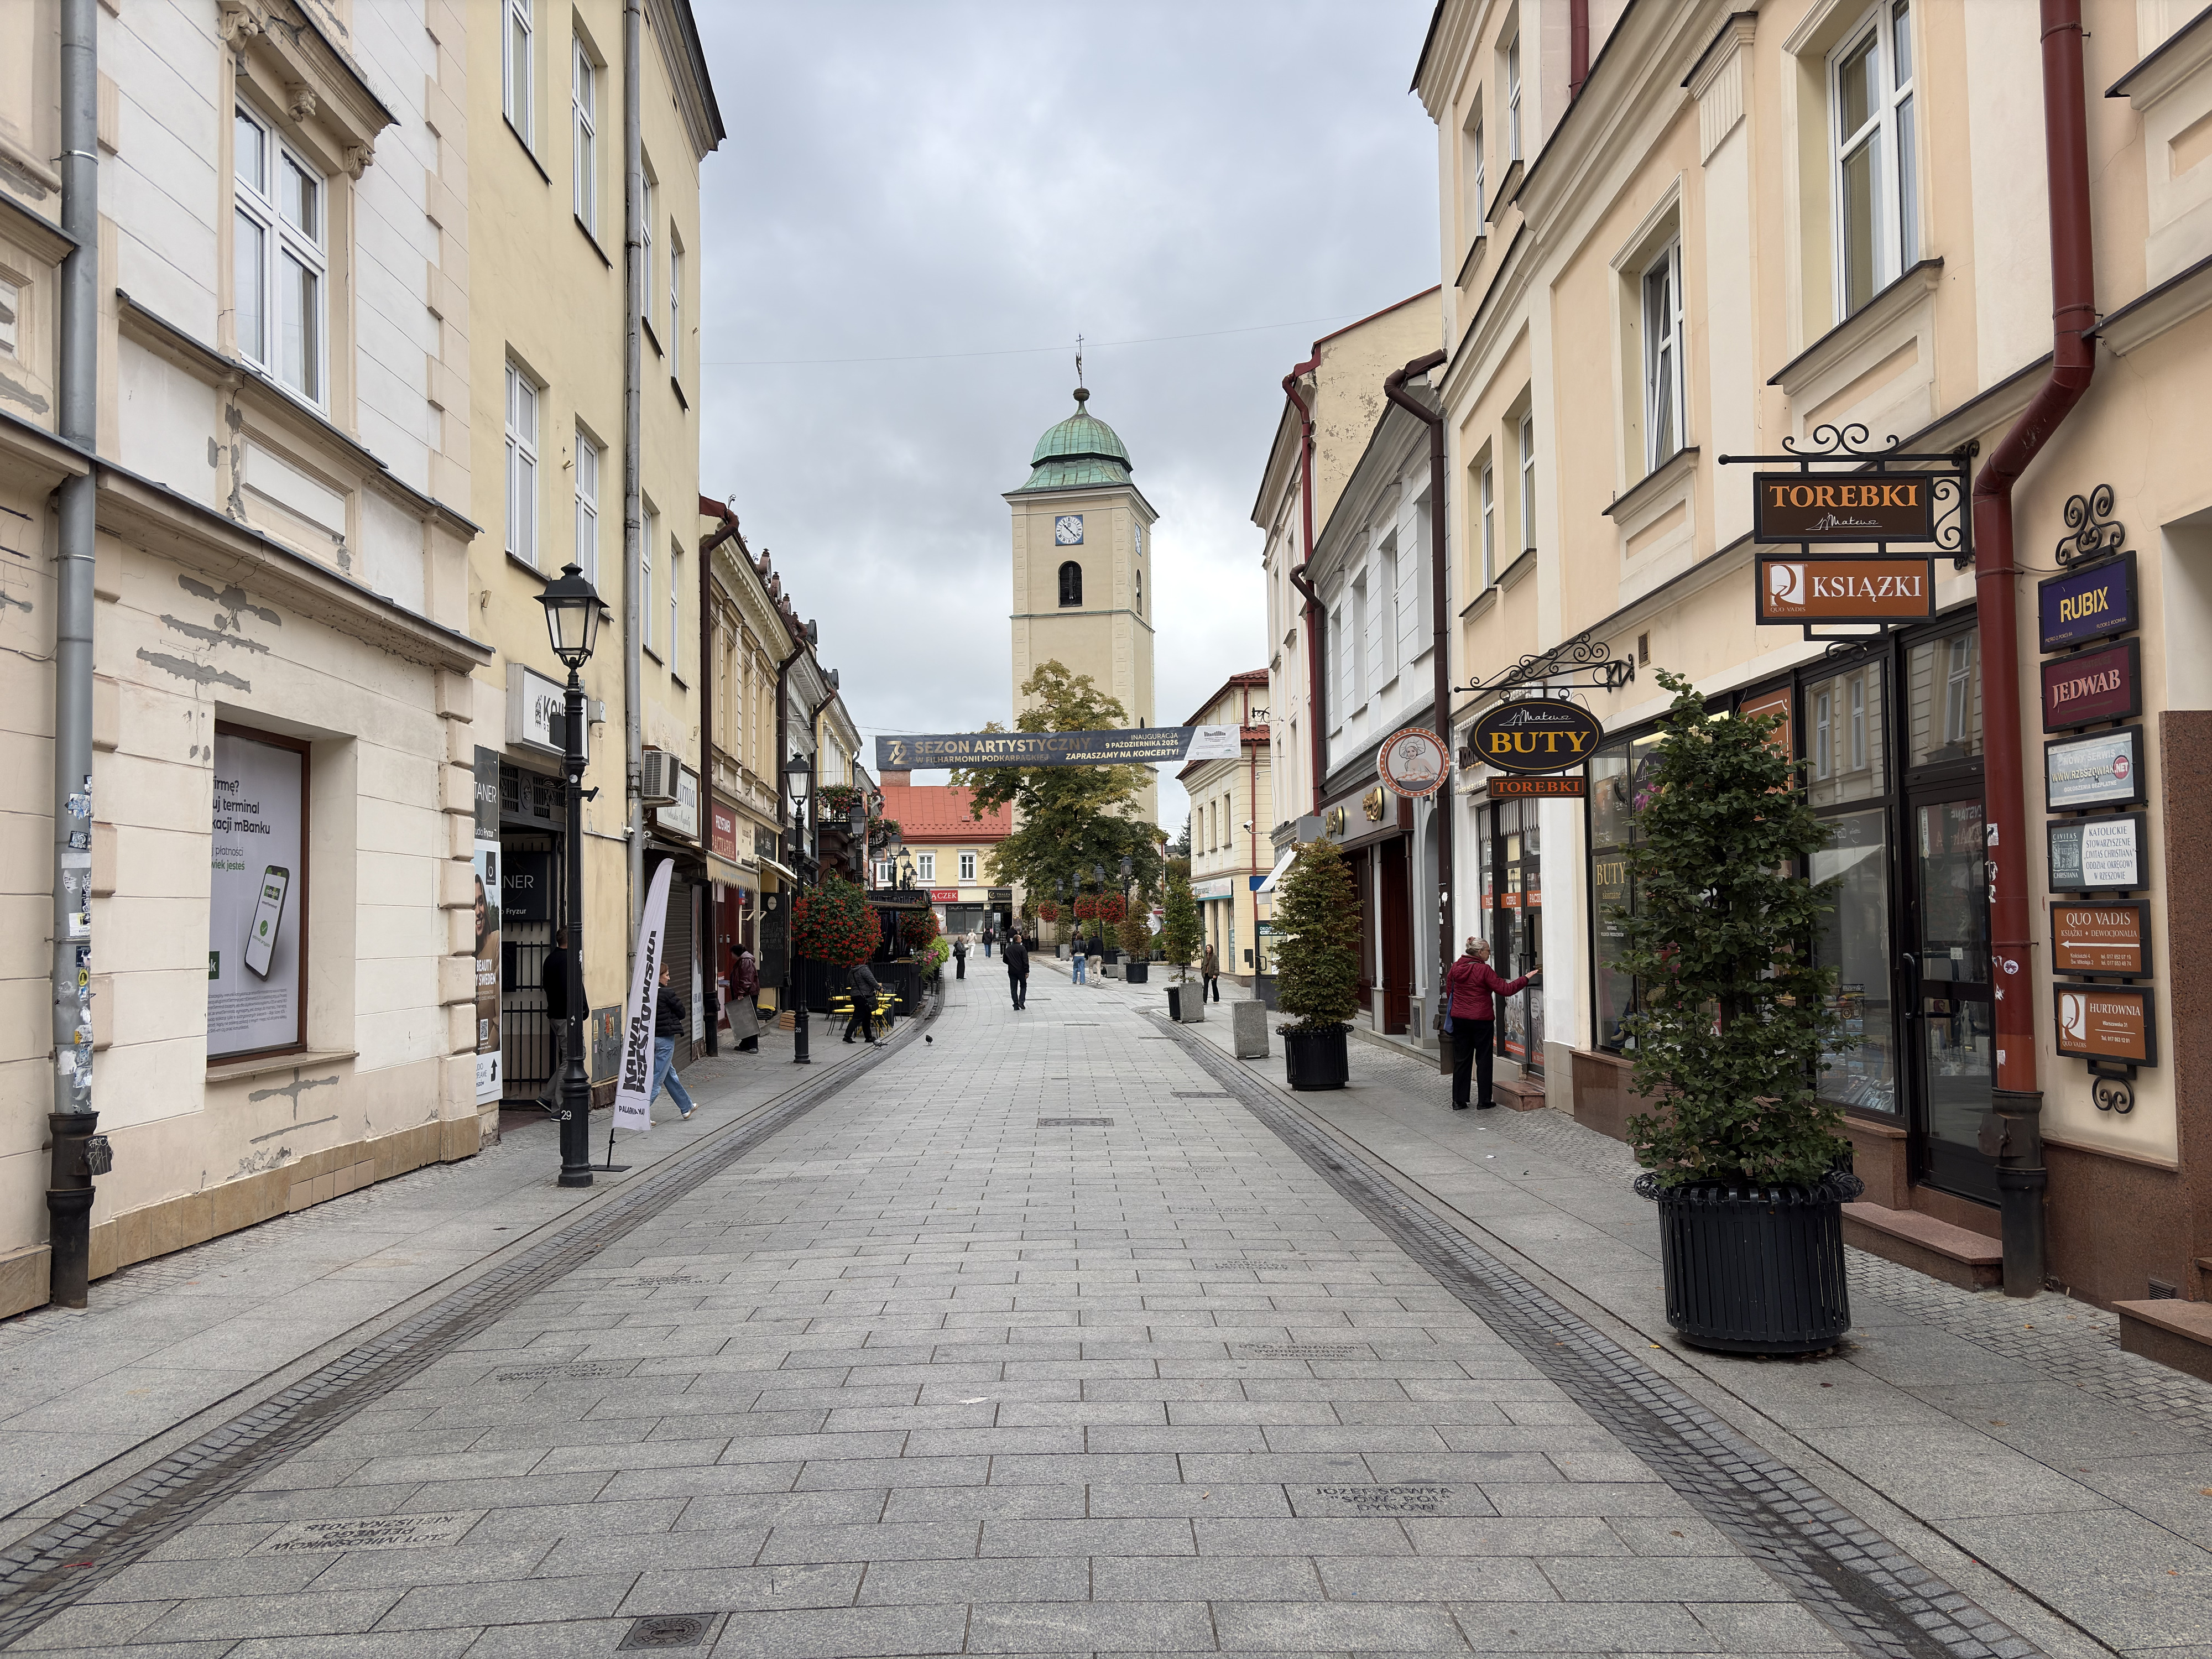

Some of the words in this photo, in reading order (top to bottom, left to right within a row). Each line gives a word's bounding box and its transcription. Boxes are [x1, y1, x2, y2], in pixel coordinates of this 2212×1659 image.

[1770, 485, 1918, 508] TOREBKI
[1812, 576, 1922, 602] KSIĄŻKI
[2060, 586, 2109, 623] RUBIX
[2052, 669, 2121, 708] JEDWAB
[915, 740, 969, 754] SEZON
[974, 738, 1091, 753] ARTYSTYCZNY
[1111, 739, 1160, 748] PAŹDZIERNIKA
[1489, 731, 1590, 753] BUTY
[1066, 752, 1118, 760] ZAPRASZAMY
[1133, 749, 1179, 757] KONCERTY!
[2087, 749, 2116, 761] SERWIS
[2052, 762, 2128, 781] WWW.RZESZOWIAK.NET
[1496, 781, 1579, 792] TOREBKI
[2064, 784, 2091, 792] OGŁOSZENIA
[2091, 780, 2117, 789] BEZPŁATNE
[223, 799, 259, 814] terminal
[234, 820, 270, 834] mBanku
[483, 828, 494, 838] Fryzur
[2089, 826, 2127, 836] KATOLICKIE
[2086, 838, 2131, 848] STOWARZYSZENIE
[216, 846, 243, 856] płatności
[226, 860, 245, 872] jesteś
[2086, 860, 2106, 869] ODDZIAŁ
[2107, 860, 2133, 870] OKRĘGOWY
[1597, 862, 1626, 885] BUTY
[2099, 872, 2126, 880] RZESZOWIE
[506, 908, 526, 916] Fryzur
[2066, 913, 2091, 927] QUO
[2095, 912, 2130, 925] VADIS
[2061, 928, 2083, 937] KSIĄŻKI
[477, 959, 492, 972] BEAUTY
[479, 973, 496, 987] SWEDEN
[2090, 1003, 2141, 1016] HURTOWNIA
[561, 1110, 572, 1120] 29
[304, 1522, 355, 1531] 2018
[360, 1516, 455, 1527] KIELISZKA
[322, 1527, 416, 1539] PEŁNEGO
